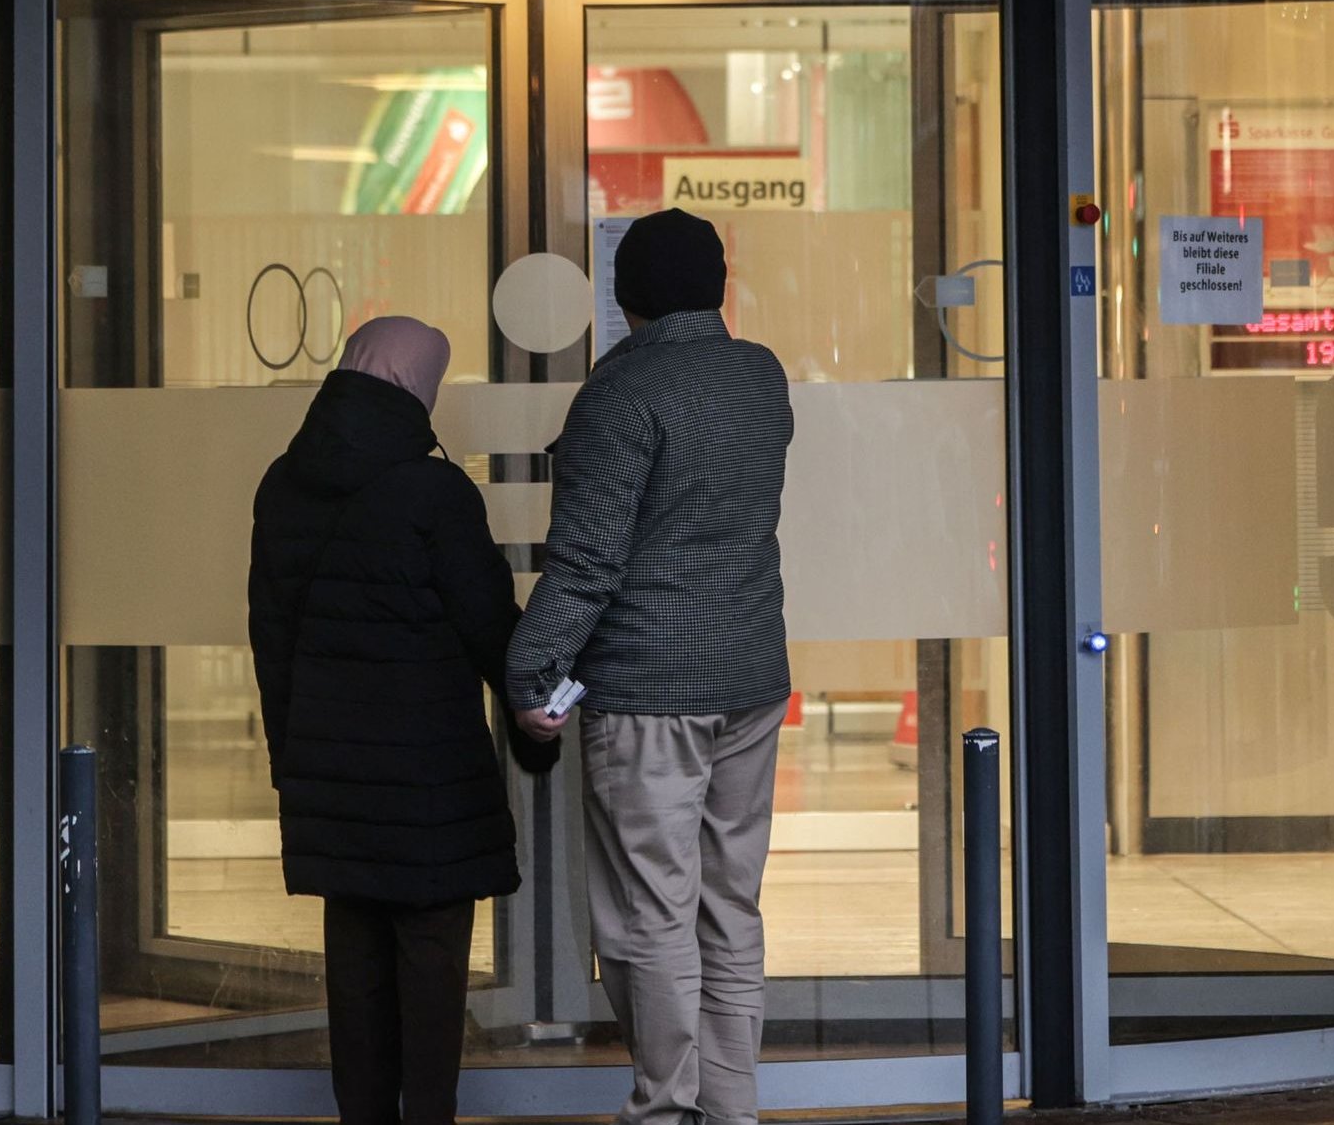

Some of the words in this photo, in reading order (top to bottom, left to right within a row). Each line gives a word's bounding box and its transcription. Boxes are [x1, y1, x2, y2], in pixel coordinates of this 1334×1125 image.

[674, 176, 806, 207] Ausgang
[1173, 230, 1188, 242] Bis
[1190, 231, 1205, 242] auf
[1207, 231, 1249, 243] Weiteres
[1183, 246, 1211, 259] bleibt
[1213, 247, 1239, 259] diese
[1196, 263, 1226, 275] Filiale
[1180, 279, 1242, 293] geschlossen!
